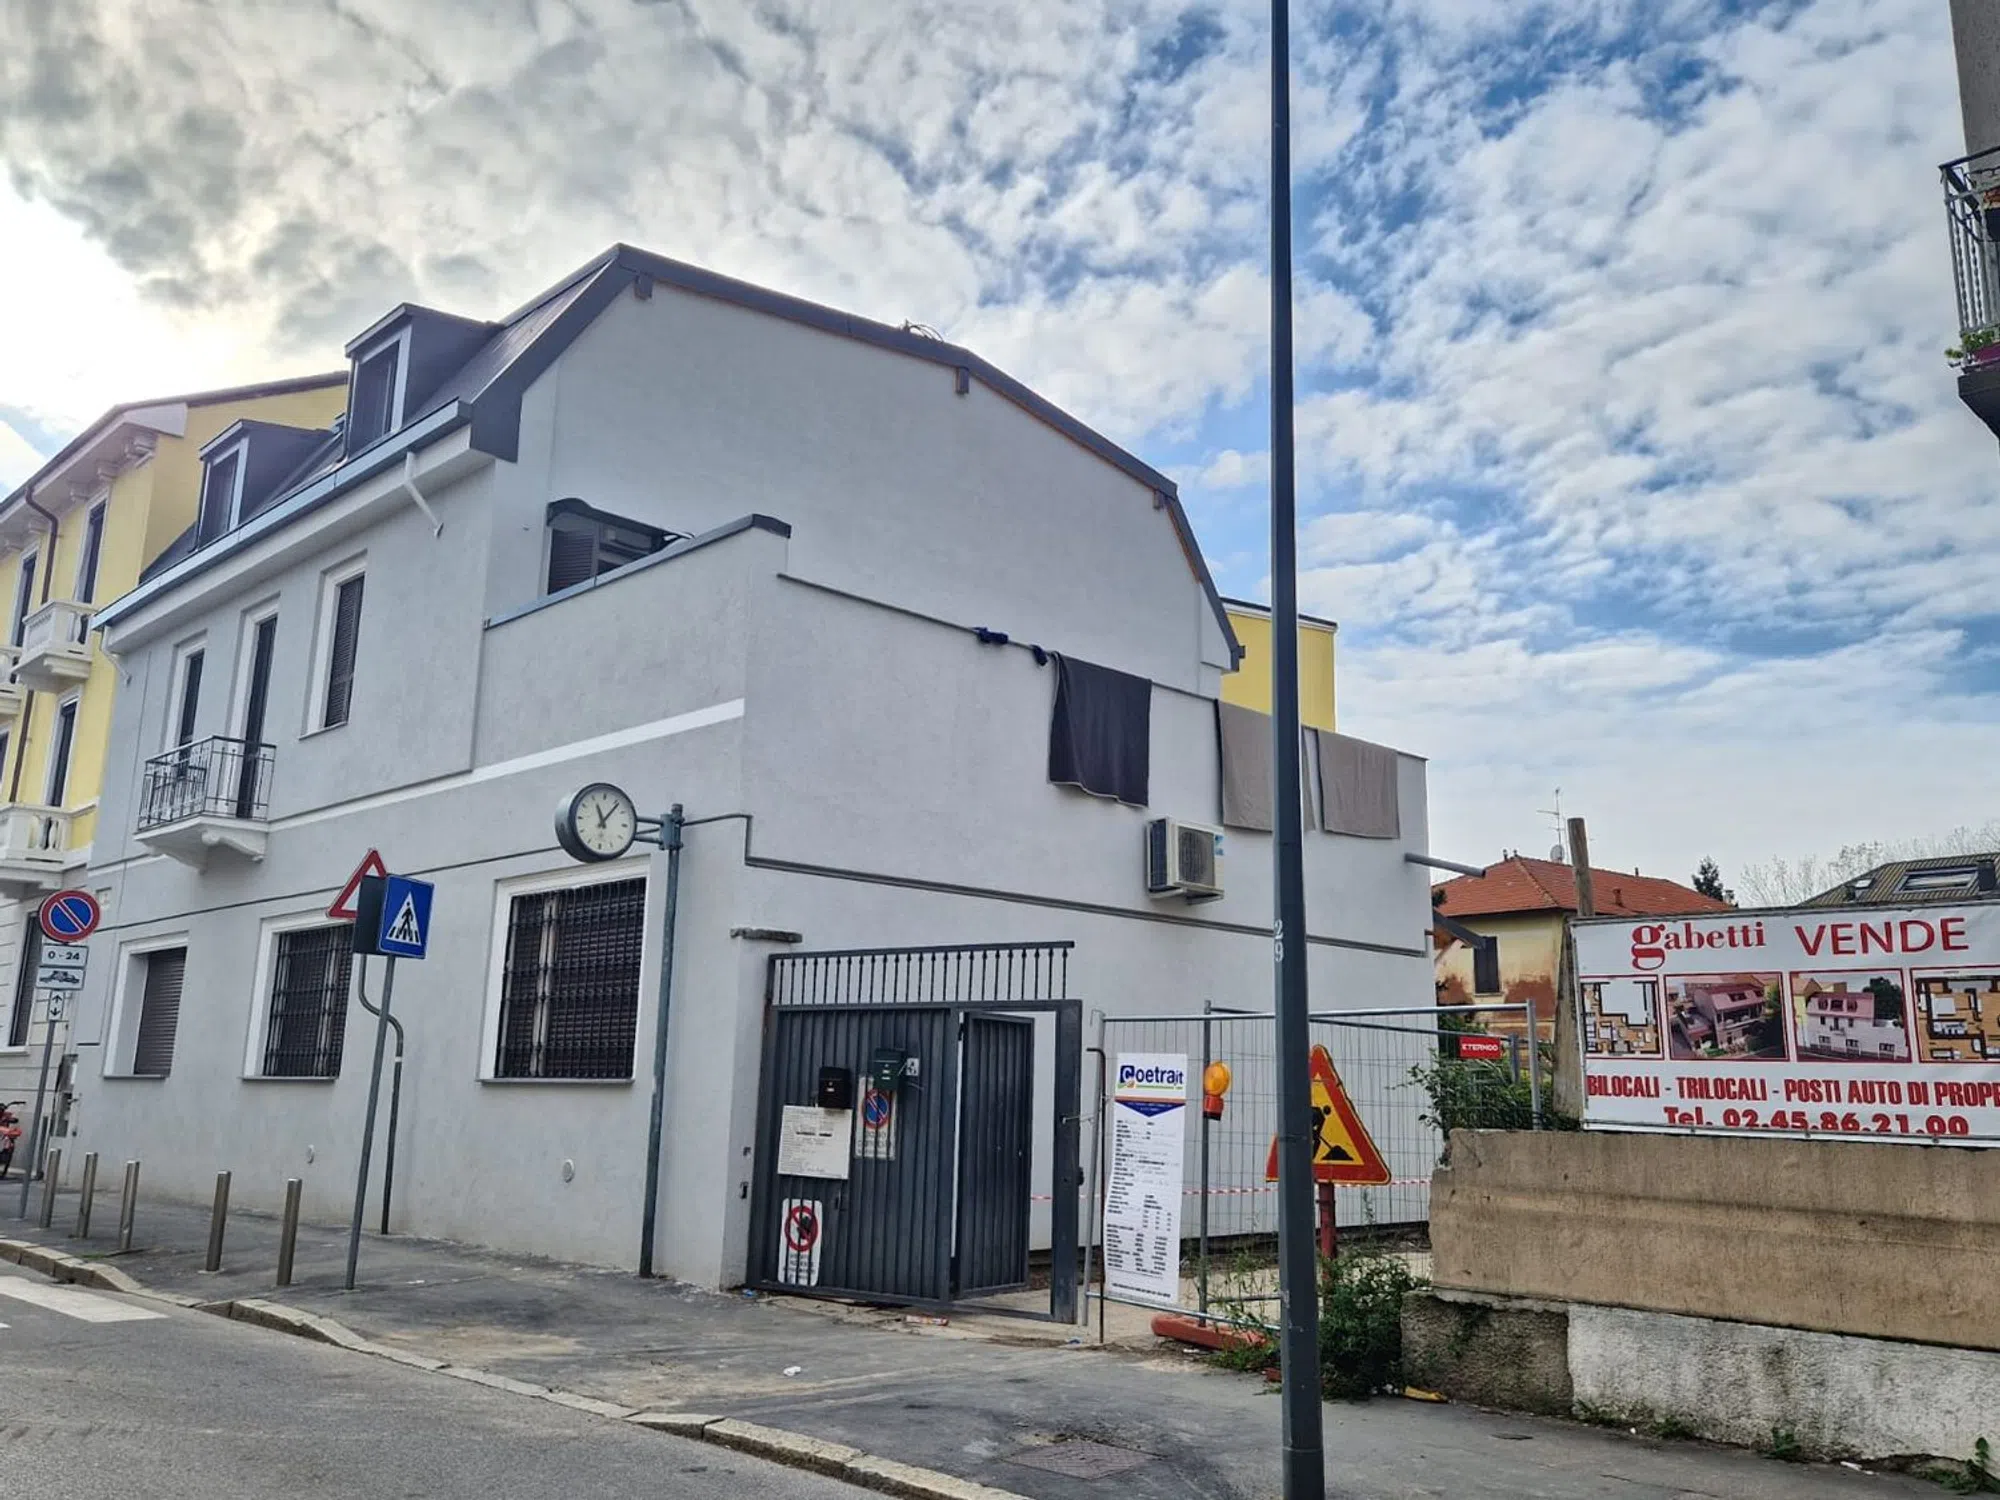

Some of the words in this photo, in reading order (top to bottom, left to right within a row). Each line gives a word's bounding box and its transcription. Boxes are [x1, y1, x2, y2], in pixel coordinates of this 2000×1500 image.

[65, 951, 80, 960] 24
[1631, 921, 1767, 971] gabetti
[1794, 917, 1969, 956] VENDE
[1587, 1075, 1660, 1098] BILOCALI
[1676, 1077, 1767, 1101] TRILOCALI
[1784, 1079, 1842, 1103] POSTI
[1848, 1080, 1900, 1104] AUTO
[1907, 1081, 1929, 1106] DI
[1664, 1106, 1713, 1126] Tel.
